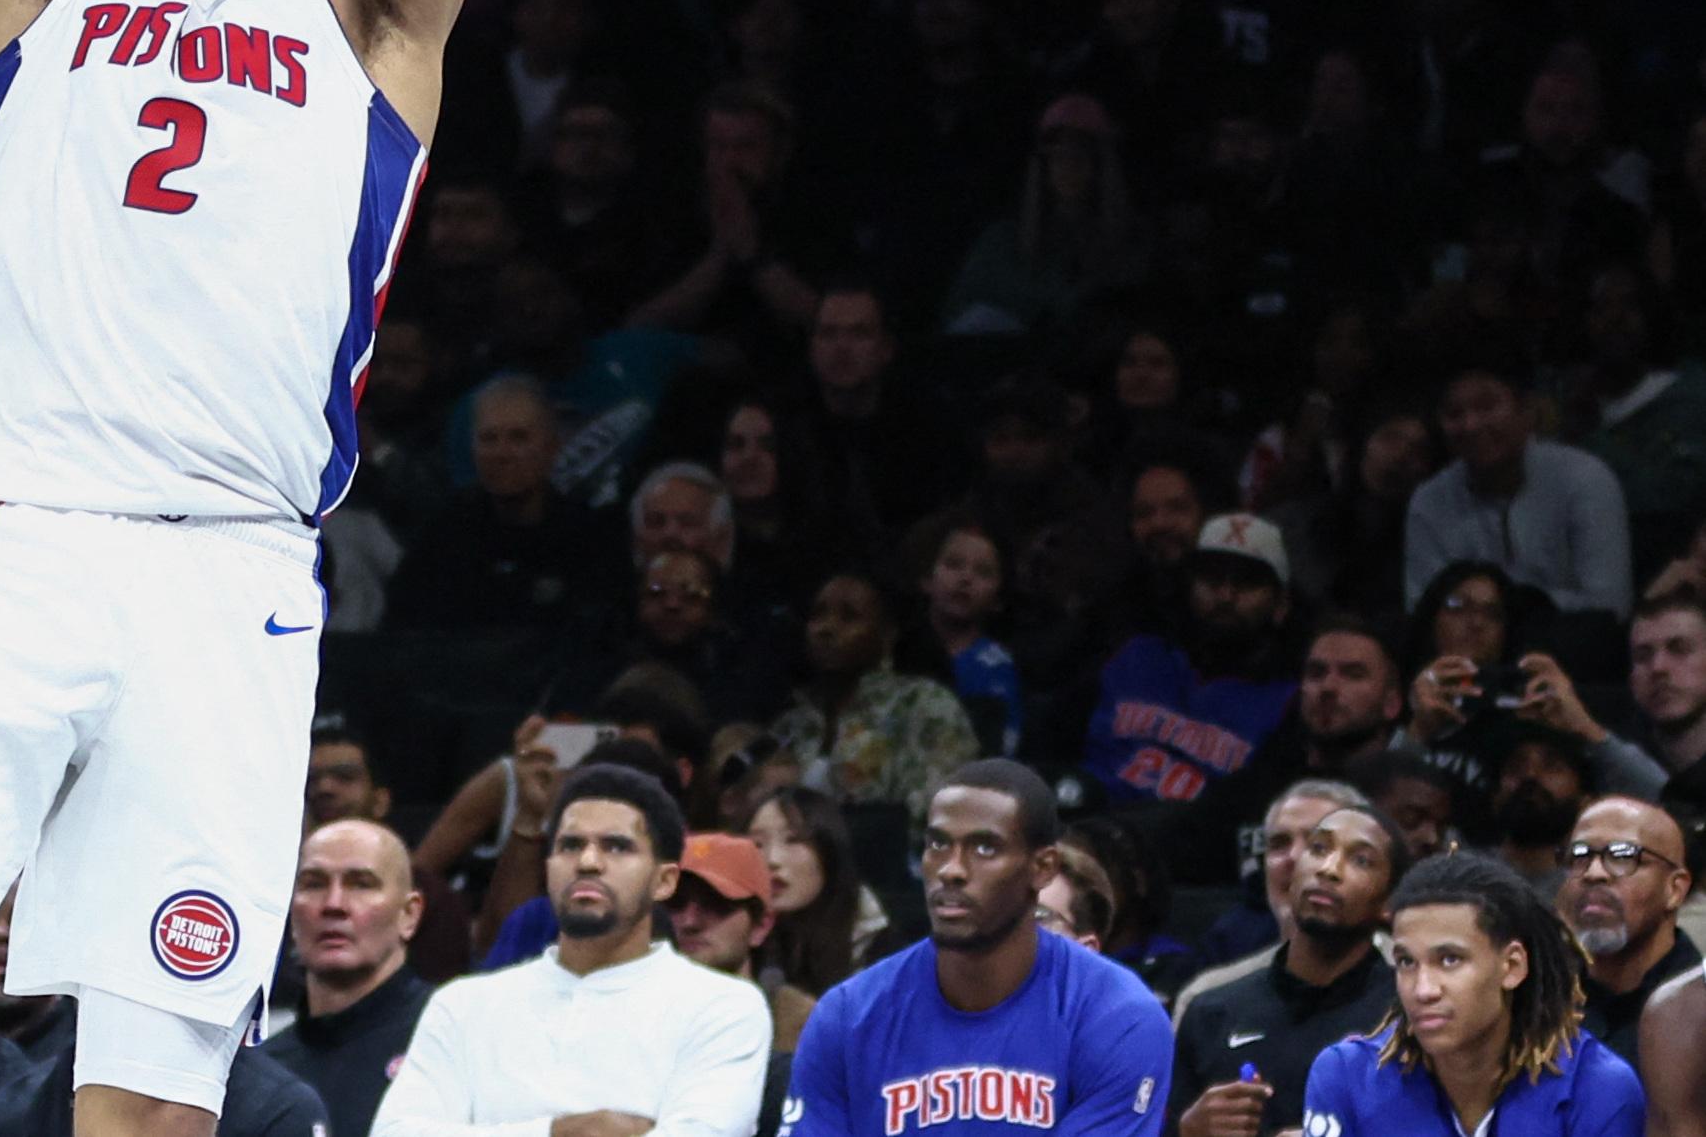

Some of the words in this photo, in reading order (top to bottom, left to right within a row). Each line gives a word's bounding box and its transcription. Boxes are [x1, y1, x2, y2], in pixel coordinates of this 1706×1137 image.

[69, 1, 309, 108] PISONS
[122, 97, 208, 215] 2
[165, 928, 222, 957] PISTONS
[170, 914, 225, 942] DETROIT
[882, 1066, 1057, 1137] PISTONS
